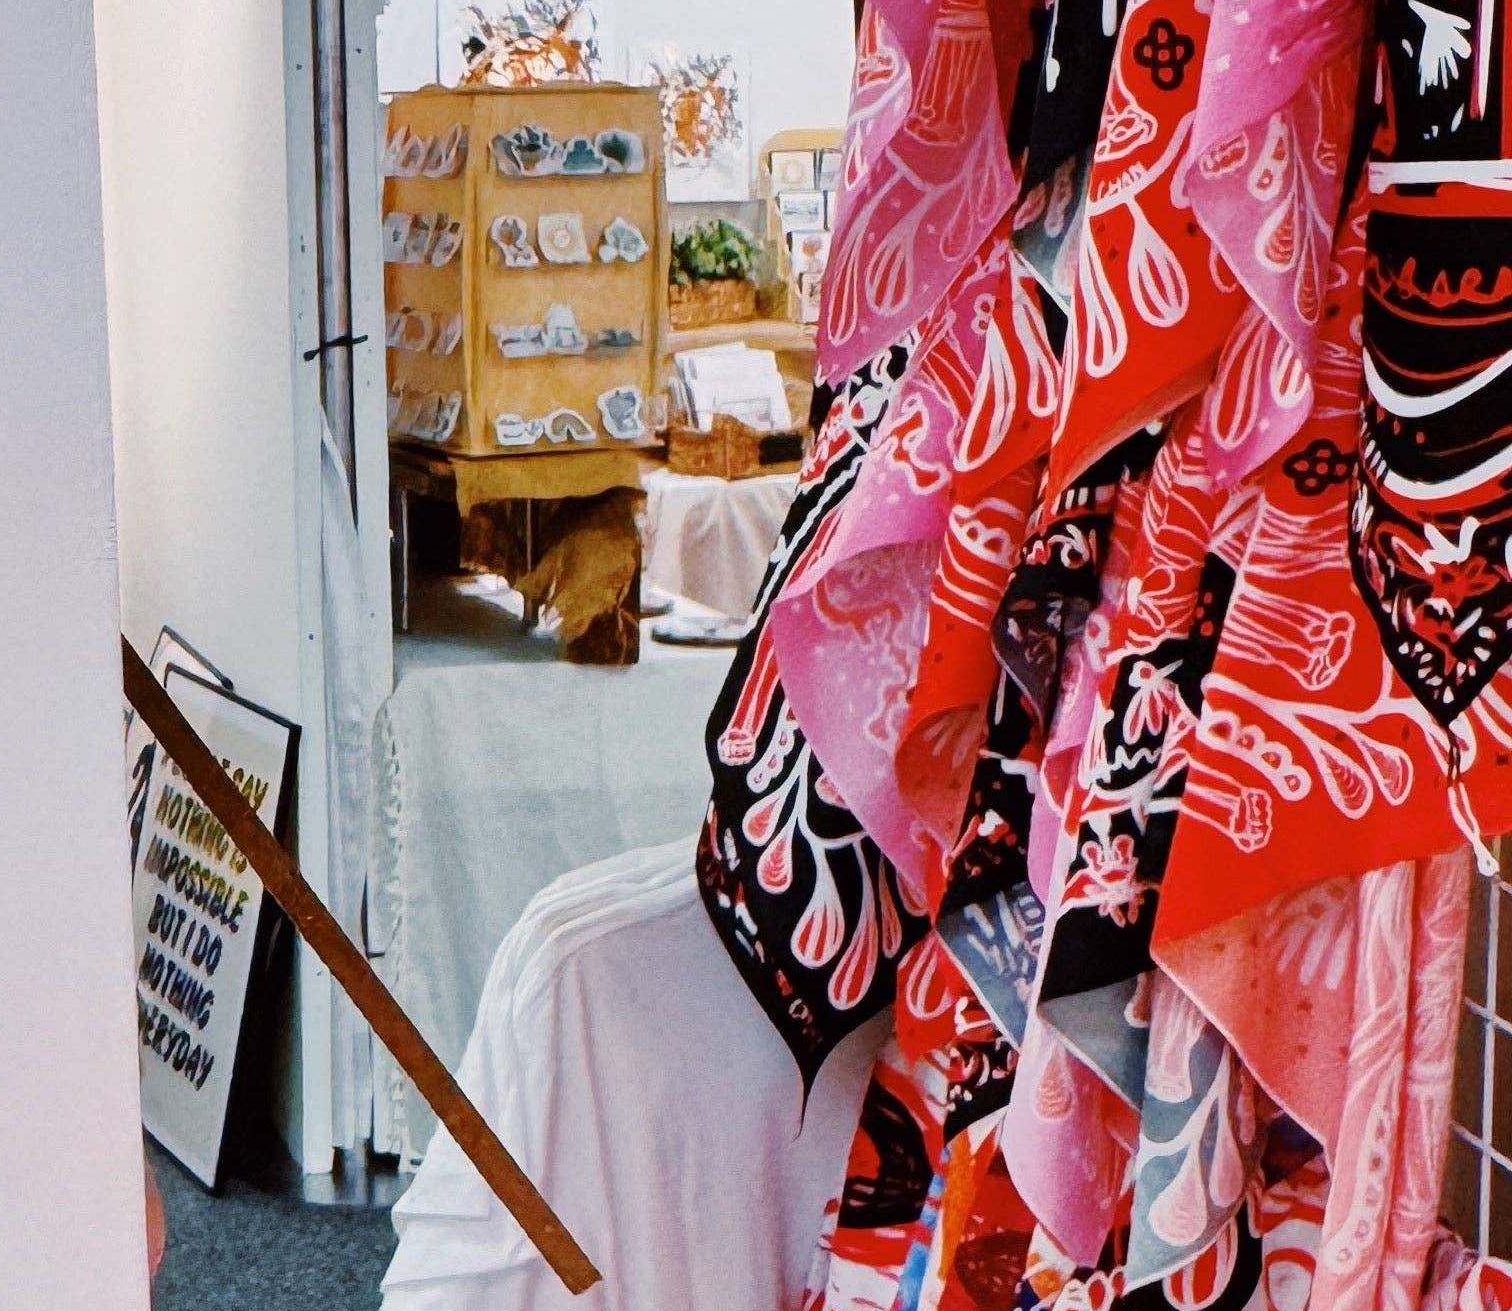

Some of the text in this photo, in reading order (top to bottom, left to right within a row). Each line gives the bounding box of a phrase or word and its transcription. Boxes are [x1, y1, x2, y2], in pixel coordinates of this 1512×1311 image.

[155, 783, 230, 862] NOTHING
[143, 832, 250, 934] IMPOSSIBLE
[147, 893, 223, 977] BUT I DO
[138, 941, 215, 1031] NOTHING
